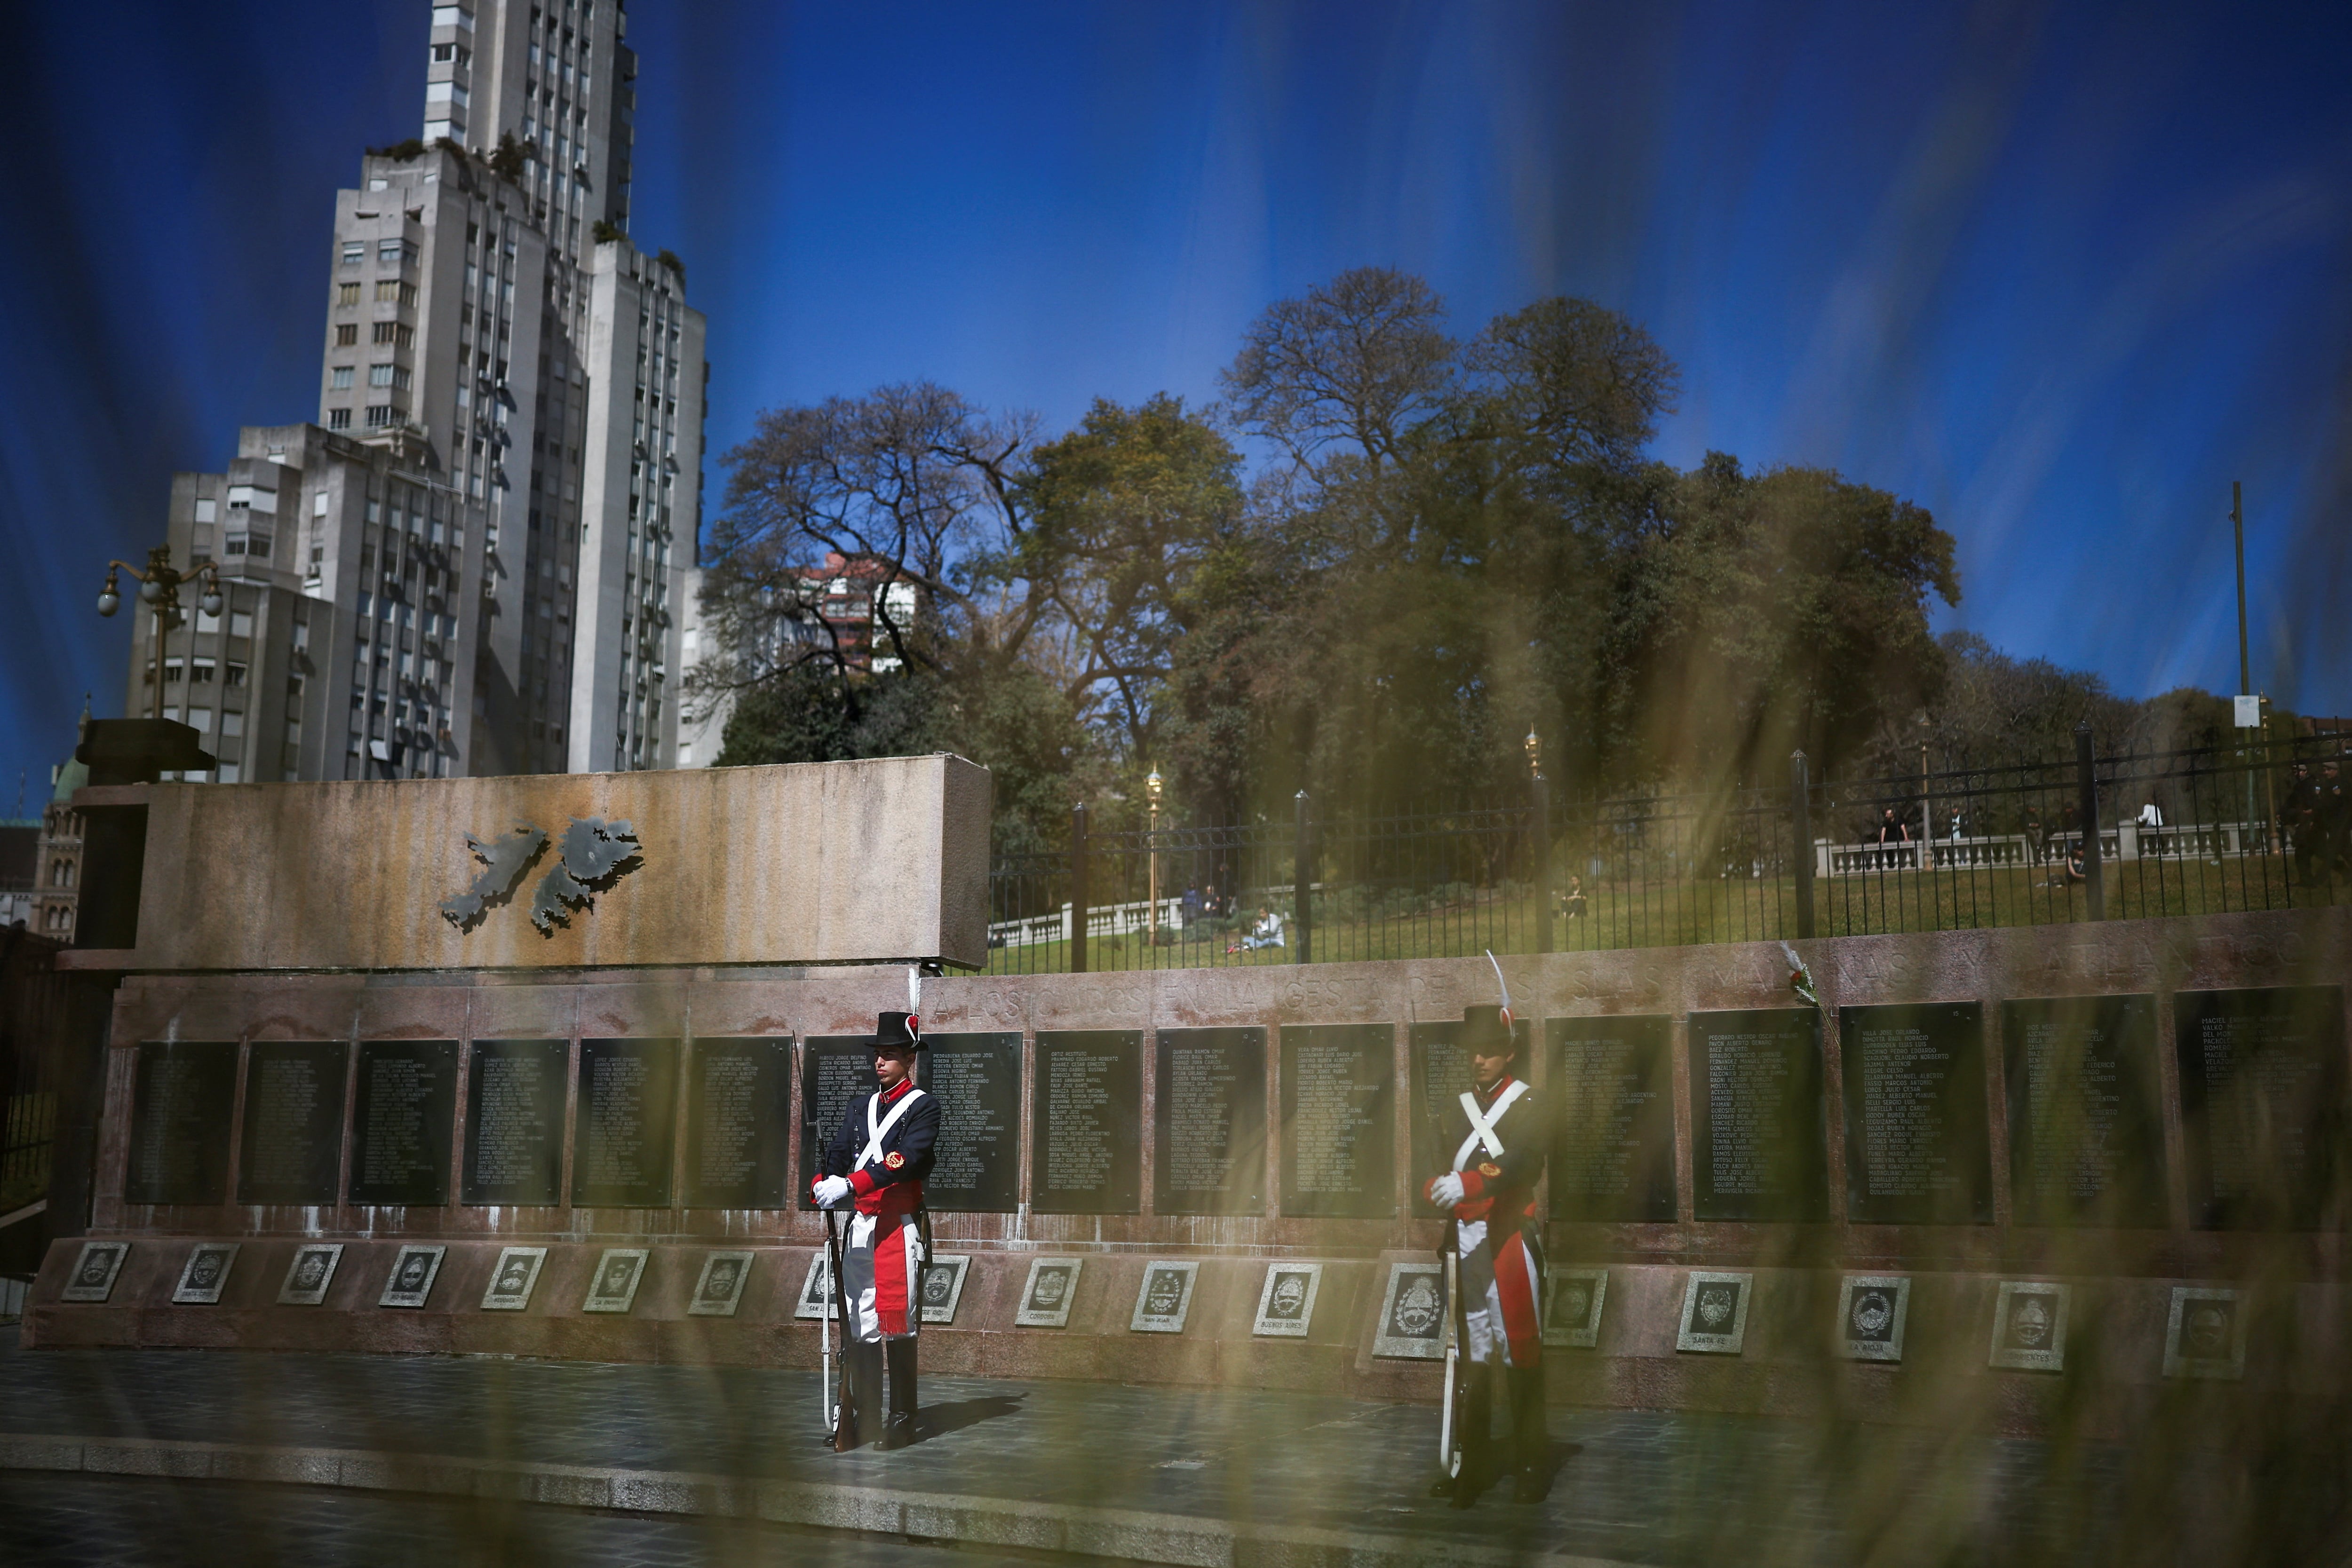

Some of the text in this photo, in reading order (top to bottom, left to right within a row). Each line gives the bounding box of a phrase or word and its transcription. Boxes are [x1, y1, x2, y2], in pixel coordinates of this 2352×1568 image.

[1224, 982, 1259, 1013] LA
[1285, 978, 1385, 1009] GESTA
[1409, 974, 1447, 1005] DE
[1473, 972, 1532, 1005] LS
